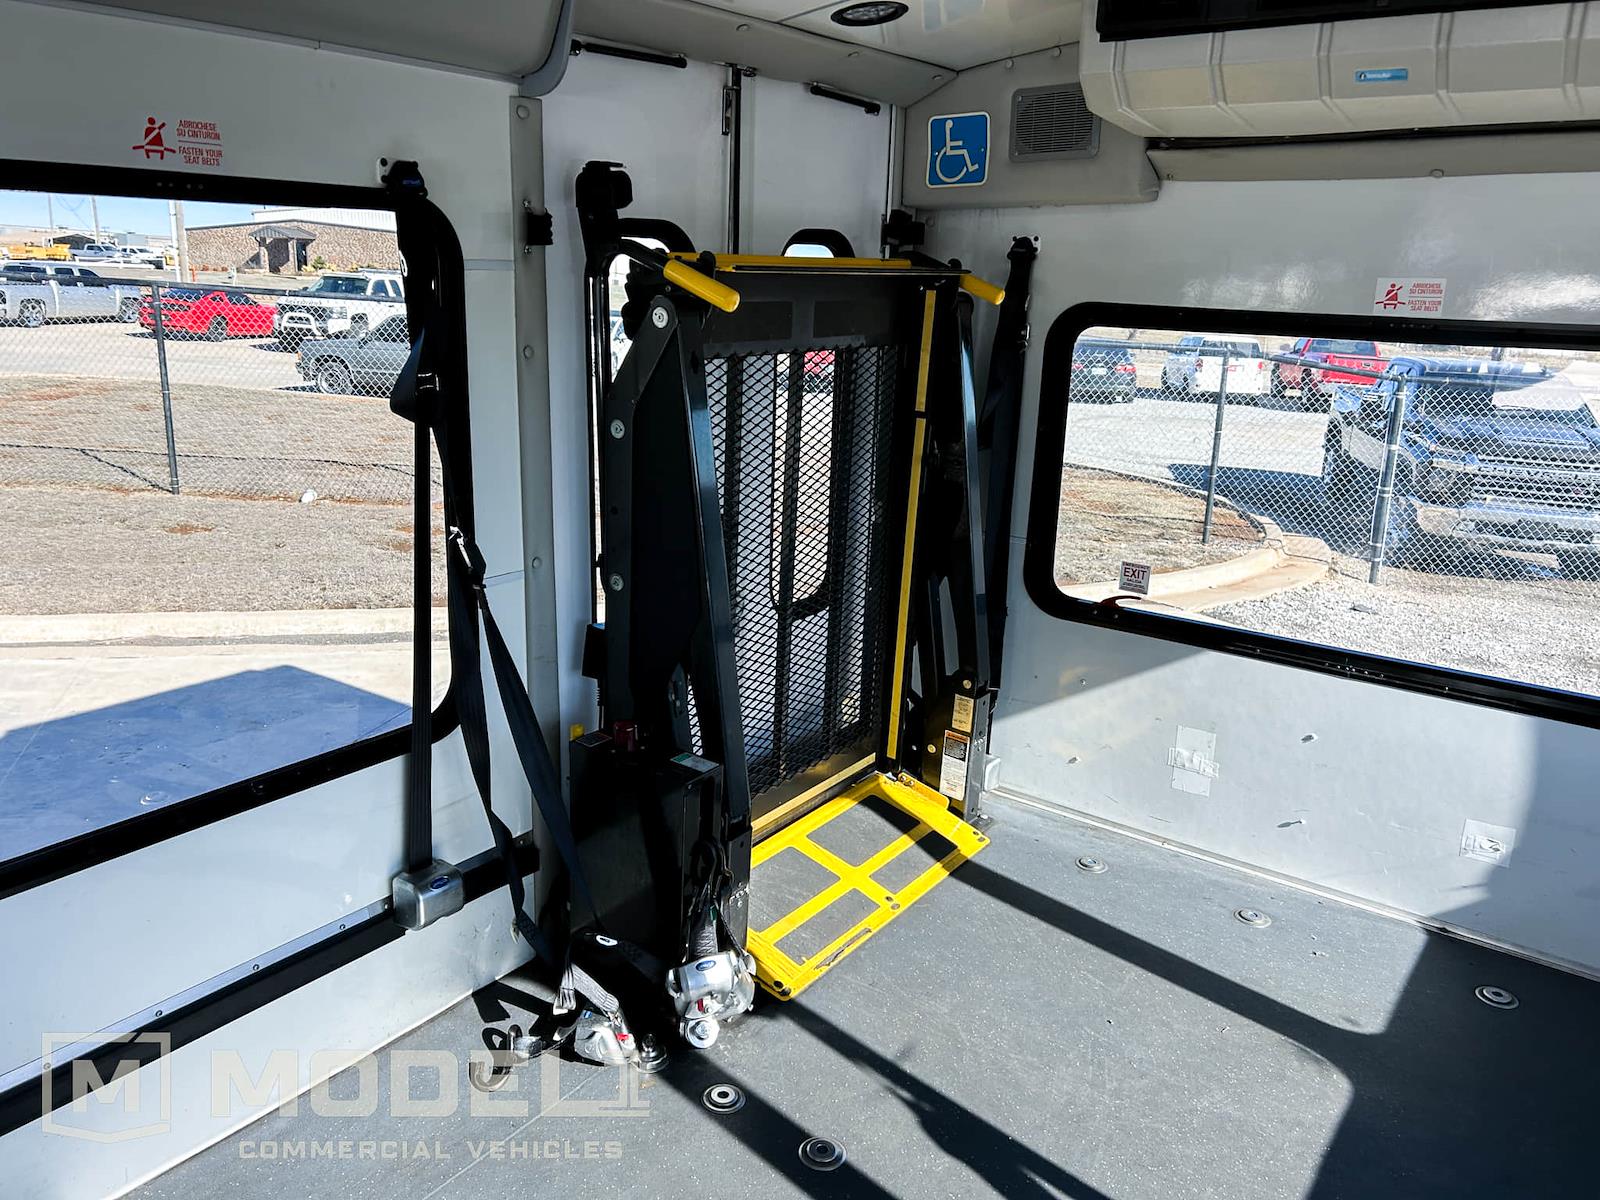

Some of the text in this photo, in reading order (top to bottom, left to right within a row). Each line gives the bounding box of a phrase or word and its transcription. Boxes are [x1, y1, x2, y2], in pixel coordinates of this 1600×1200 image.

[178, 119, 217, 131] ABROCHESE
[176, 128, 221, 141] SU CINTURON
[178, 146, 223, 158] FASTEN YOUR
[184, 155, 220, 167] SEAT BELTS
[1123, 566, 1148, 581] EXIT
